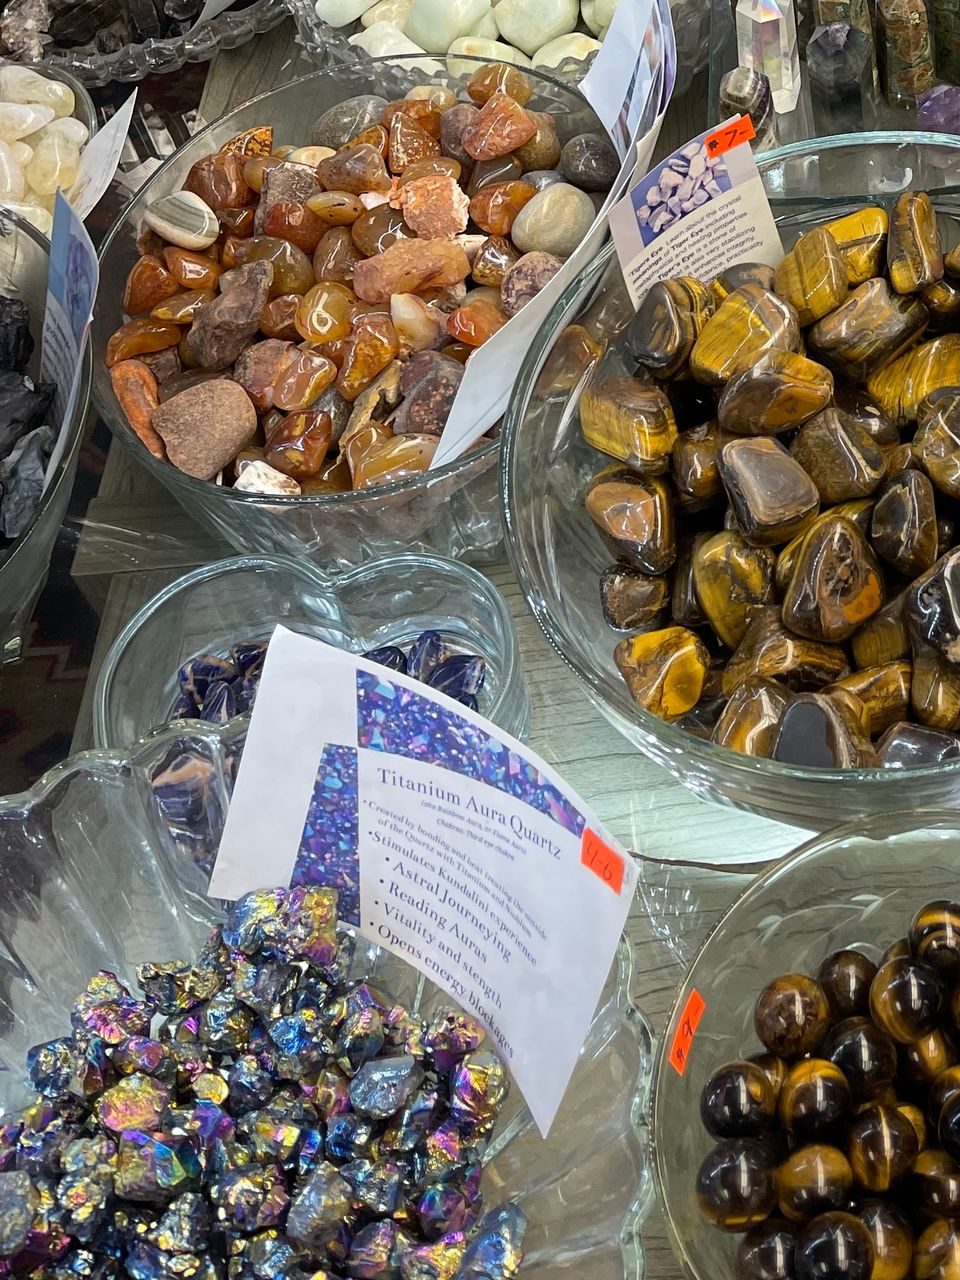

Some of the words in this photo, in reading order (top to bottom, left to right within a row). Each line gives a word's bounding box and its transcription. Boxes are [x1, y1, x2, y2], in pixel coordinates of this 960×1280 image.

[632, 255, 663, 286] meanings
[663, 249, 671, 258] of
[671, 236, 690, 252] Tiger
[690, 227, 704, 240] Eye
[705, 208, 736, 229] including
[634, 256, 673, 293] metaphysical
[674, 247, 687, 258] and
[687, 231, 713, 250] healing
[713, 211, 748, 235] properties
[657, 261, 681, 280] Tiger's
[681, 252, 695, 263] Eye
[708, 231, 728, 245] stone
[728, 225, 737, 234] of
[665, 230, 685, 246] Learn
[685, 216, 705, 233] about
[705, 209, 717, 219] the
[718, 194, 742, 212] crystal
[691, 254, 705, 265] also
[705, 245, 720, 256] very
[720, 225, 756, 247] stabilizing
[726, 240, 764, 263] practicality
[693, 251, 726, 273] enhances
[377, 767, 461, 806] Titanium
[465, 795, 507, 826] Aura
[510, 814, 562, 860] Quartz
[466, 830, 484, 843] Third
[483, 839, 494, 849] eye
[494, 844, 515, 861] chakra
[484, 825, 493, 833] or
[492, 829, 510, 844] Flame
[368, 801, 405, 823] Created
[405, 817, 416, 830] by
[417, 824, 450, 852] bonding
[451, 847, 467, 861] and
[466, 856, 483, 875] heat
[484, 871, 513, 903] treating
[513, 898, 525, 913] the
[524, 911, 548, 941] outside
[372, 830, 435, 872] Stimulates
[438, 866, 490, 913] Kundalini
[490, 910, 537, 967] experience
[377, 818, 390, 828] of
[389, 822, 404, 835] the
[404, 830, 435, 852] Quartz
[436, 849, 455, 867] with
[456, 861, 491, 895] Titanium
[490, 891, 505, 907] and
[504, 903, 532, 939] Niobium
[389, 881, 448, 930] Reading
[448, 922, 488, 964] Auras
[393, 861, 440, 896] Astral
[438, 889, 512, 964] Journeying
[378, 923, 422, 960] Opens
[424, 956, 467, 997] energy
[468, 990, 514, 1059] blockages
[384, 902, 436, 945] Vitality
[438, 940, 462, 964] and
[462, 960, 502, 1009] stength
